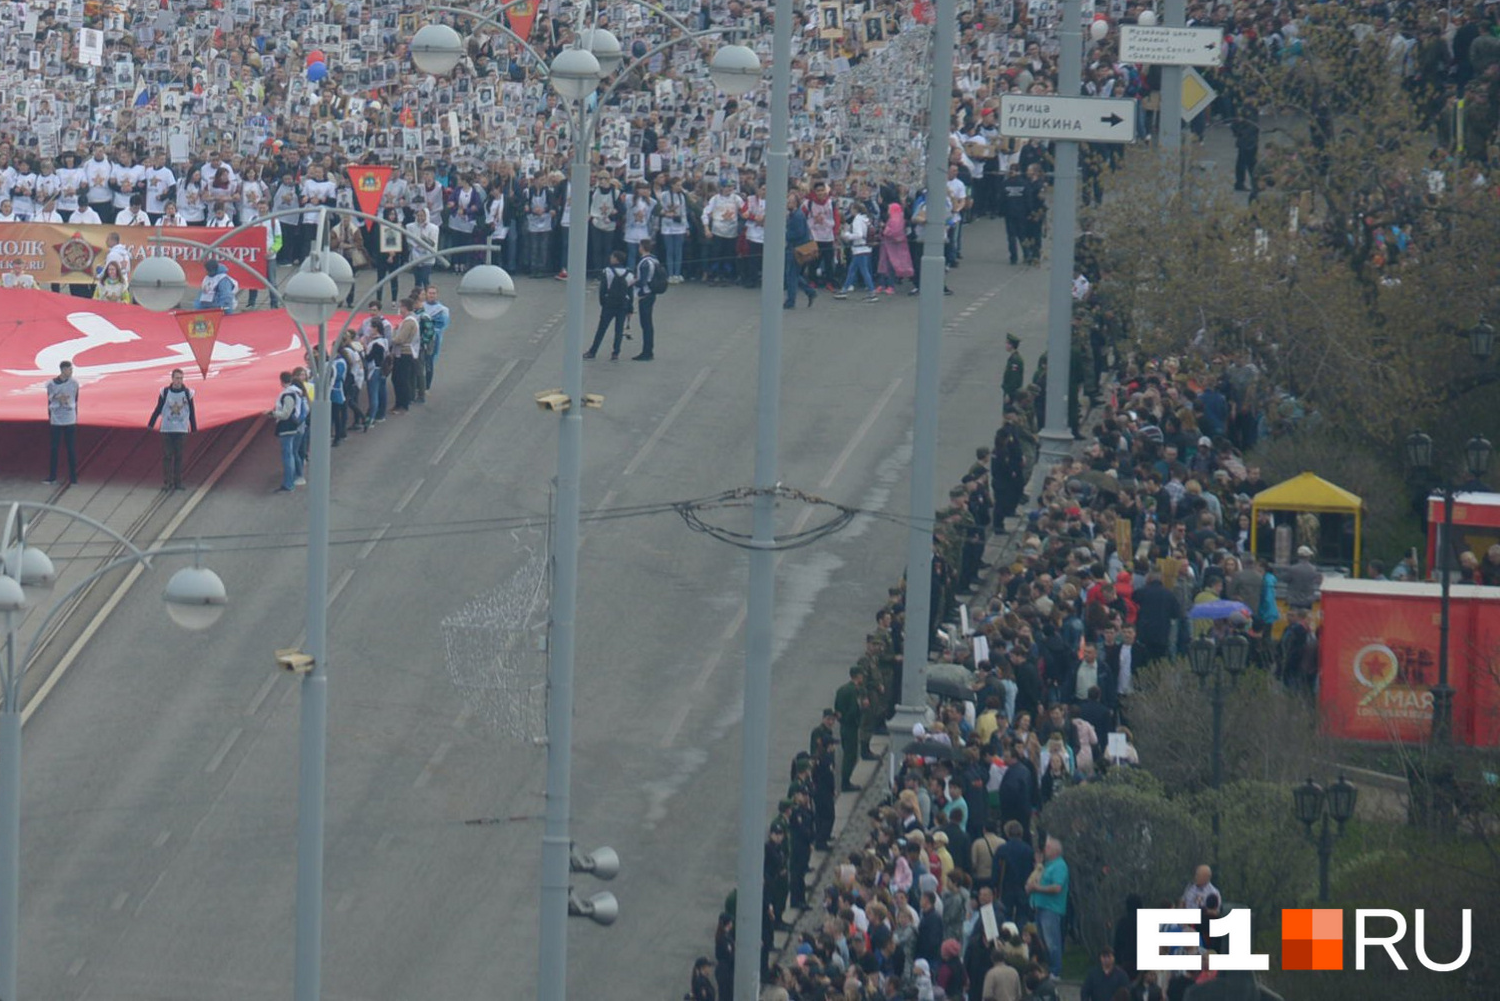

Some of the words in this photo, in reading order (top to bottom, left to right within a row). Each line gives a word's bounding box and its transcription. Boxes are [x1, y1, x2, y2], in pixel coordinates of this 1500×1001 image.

[1008, 103, 1051, 114] улица
[1008, 117, 1082, 131] ПУШКИНА
[1353, 643, 1399, 707] 9
[1384, 689, 1435, 710] МАЯ
